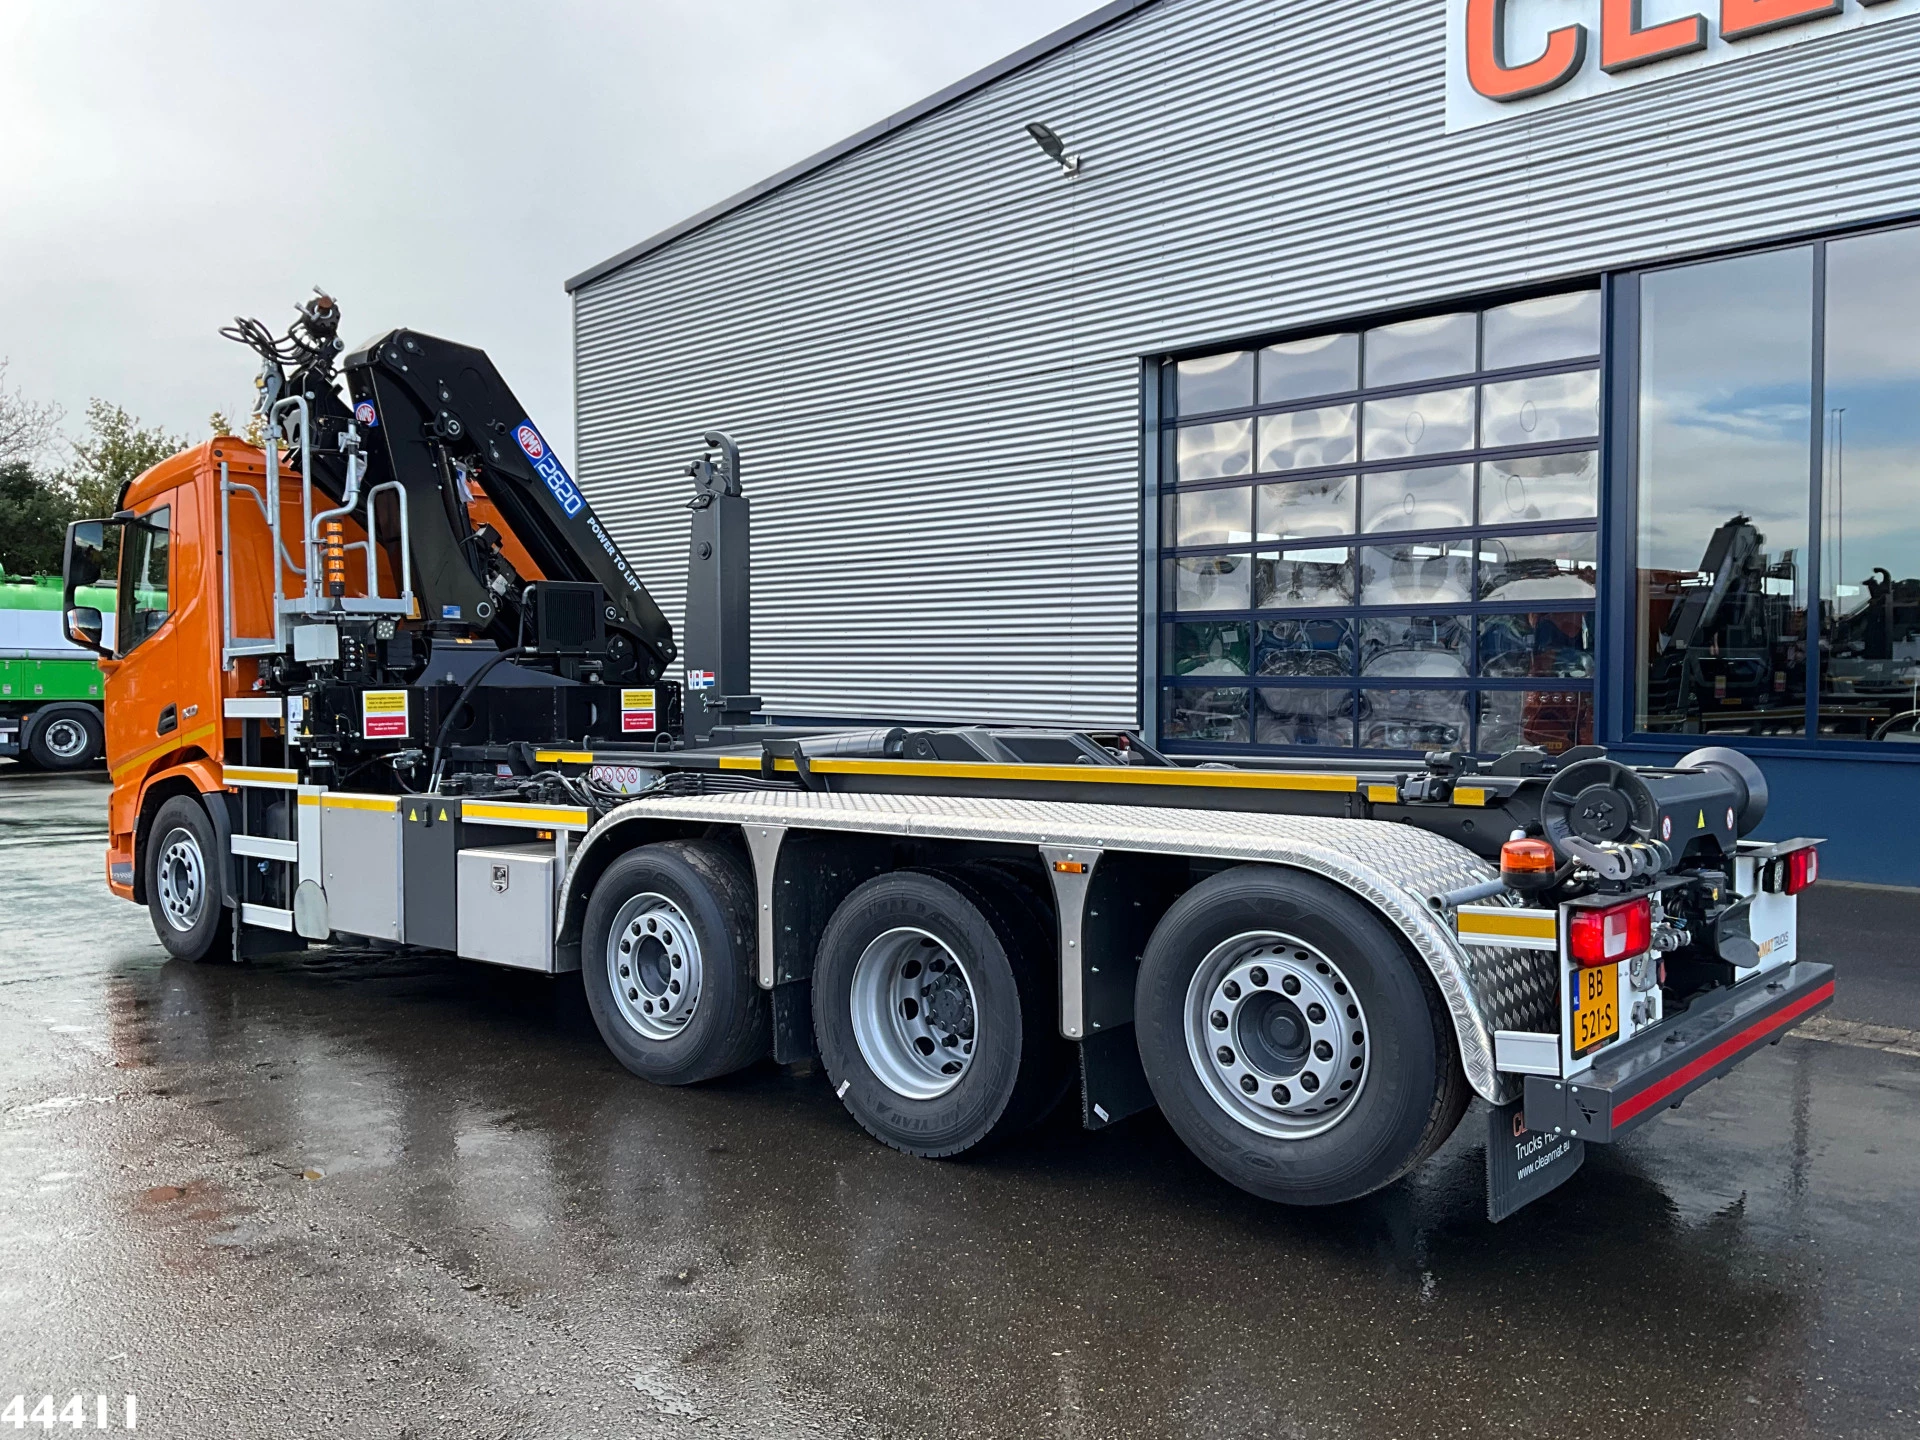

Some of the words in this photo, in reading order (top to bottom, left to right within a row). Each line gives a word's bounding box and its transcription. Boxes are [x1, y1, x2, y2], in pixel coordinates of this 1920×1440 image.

[520, 429, 541, 454] HMF
[538, 457, 581, 514] 2820
[586, 516, 616, 556] POWER
[613, 554, 626, 570] TO
[623, 570, 641, 592] LIFT
[687, 669, 707, 690] VDL
[1588, 969, 1603, 1000] BB
[1581, 1003, 1612, 1042] 521-S
[1513, 1111, 1528, 1137] CL
[1515, 1135, 1543, 1160] Trucks
[1517, 1140, 1570, 1180] www.cleanmat.eu
